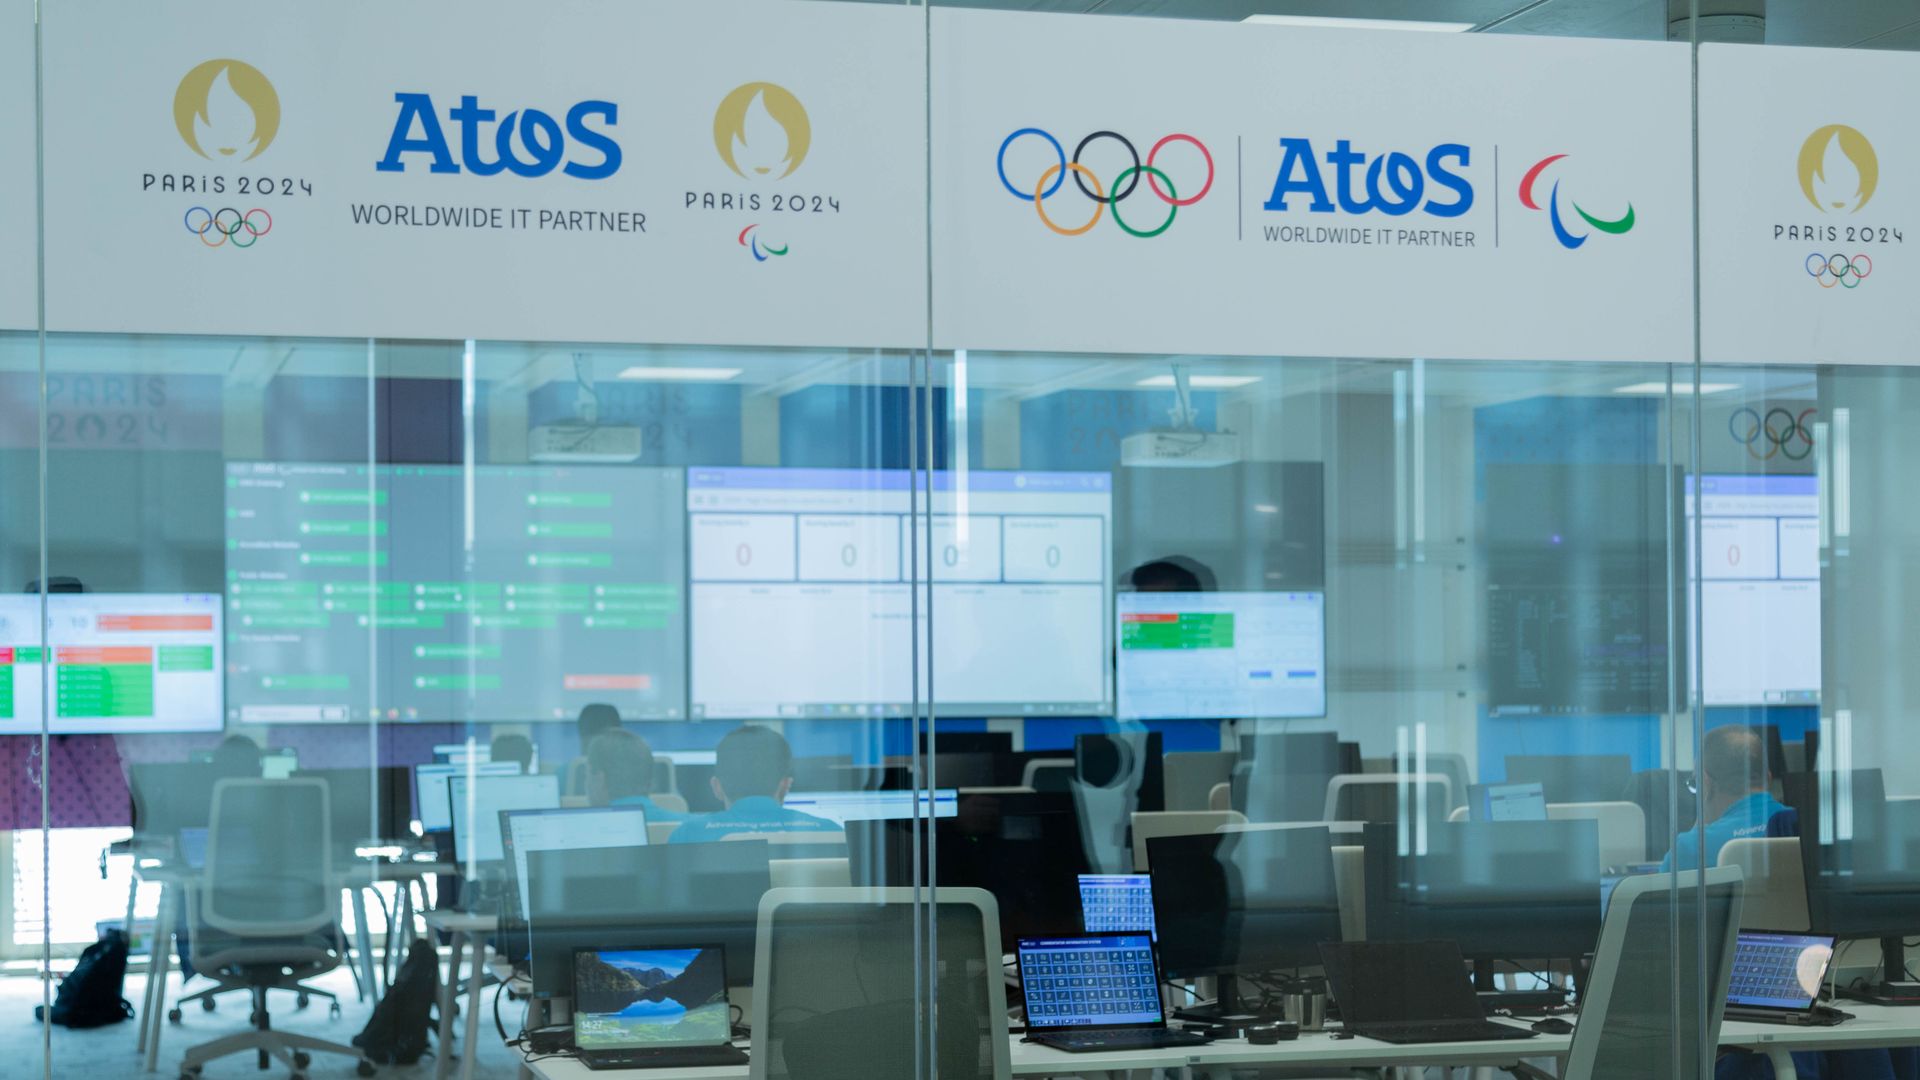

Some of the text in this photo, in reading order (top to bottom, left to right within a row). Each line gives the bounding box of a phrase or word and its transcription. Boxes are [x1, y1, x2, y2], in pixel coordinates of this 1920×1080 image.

[238, 176, 312, 196] 2024
[772, 194, 840, 213] 2024
[351, 204, 647, 232] WORLDWIDE IT PARTNER
[1264, 226, 1475, 247] WORLDWIDE IT PARTNER
[1846, 226, 1903, 243] 2024
